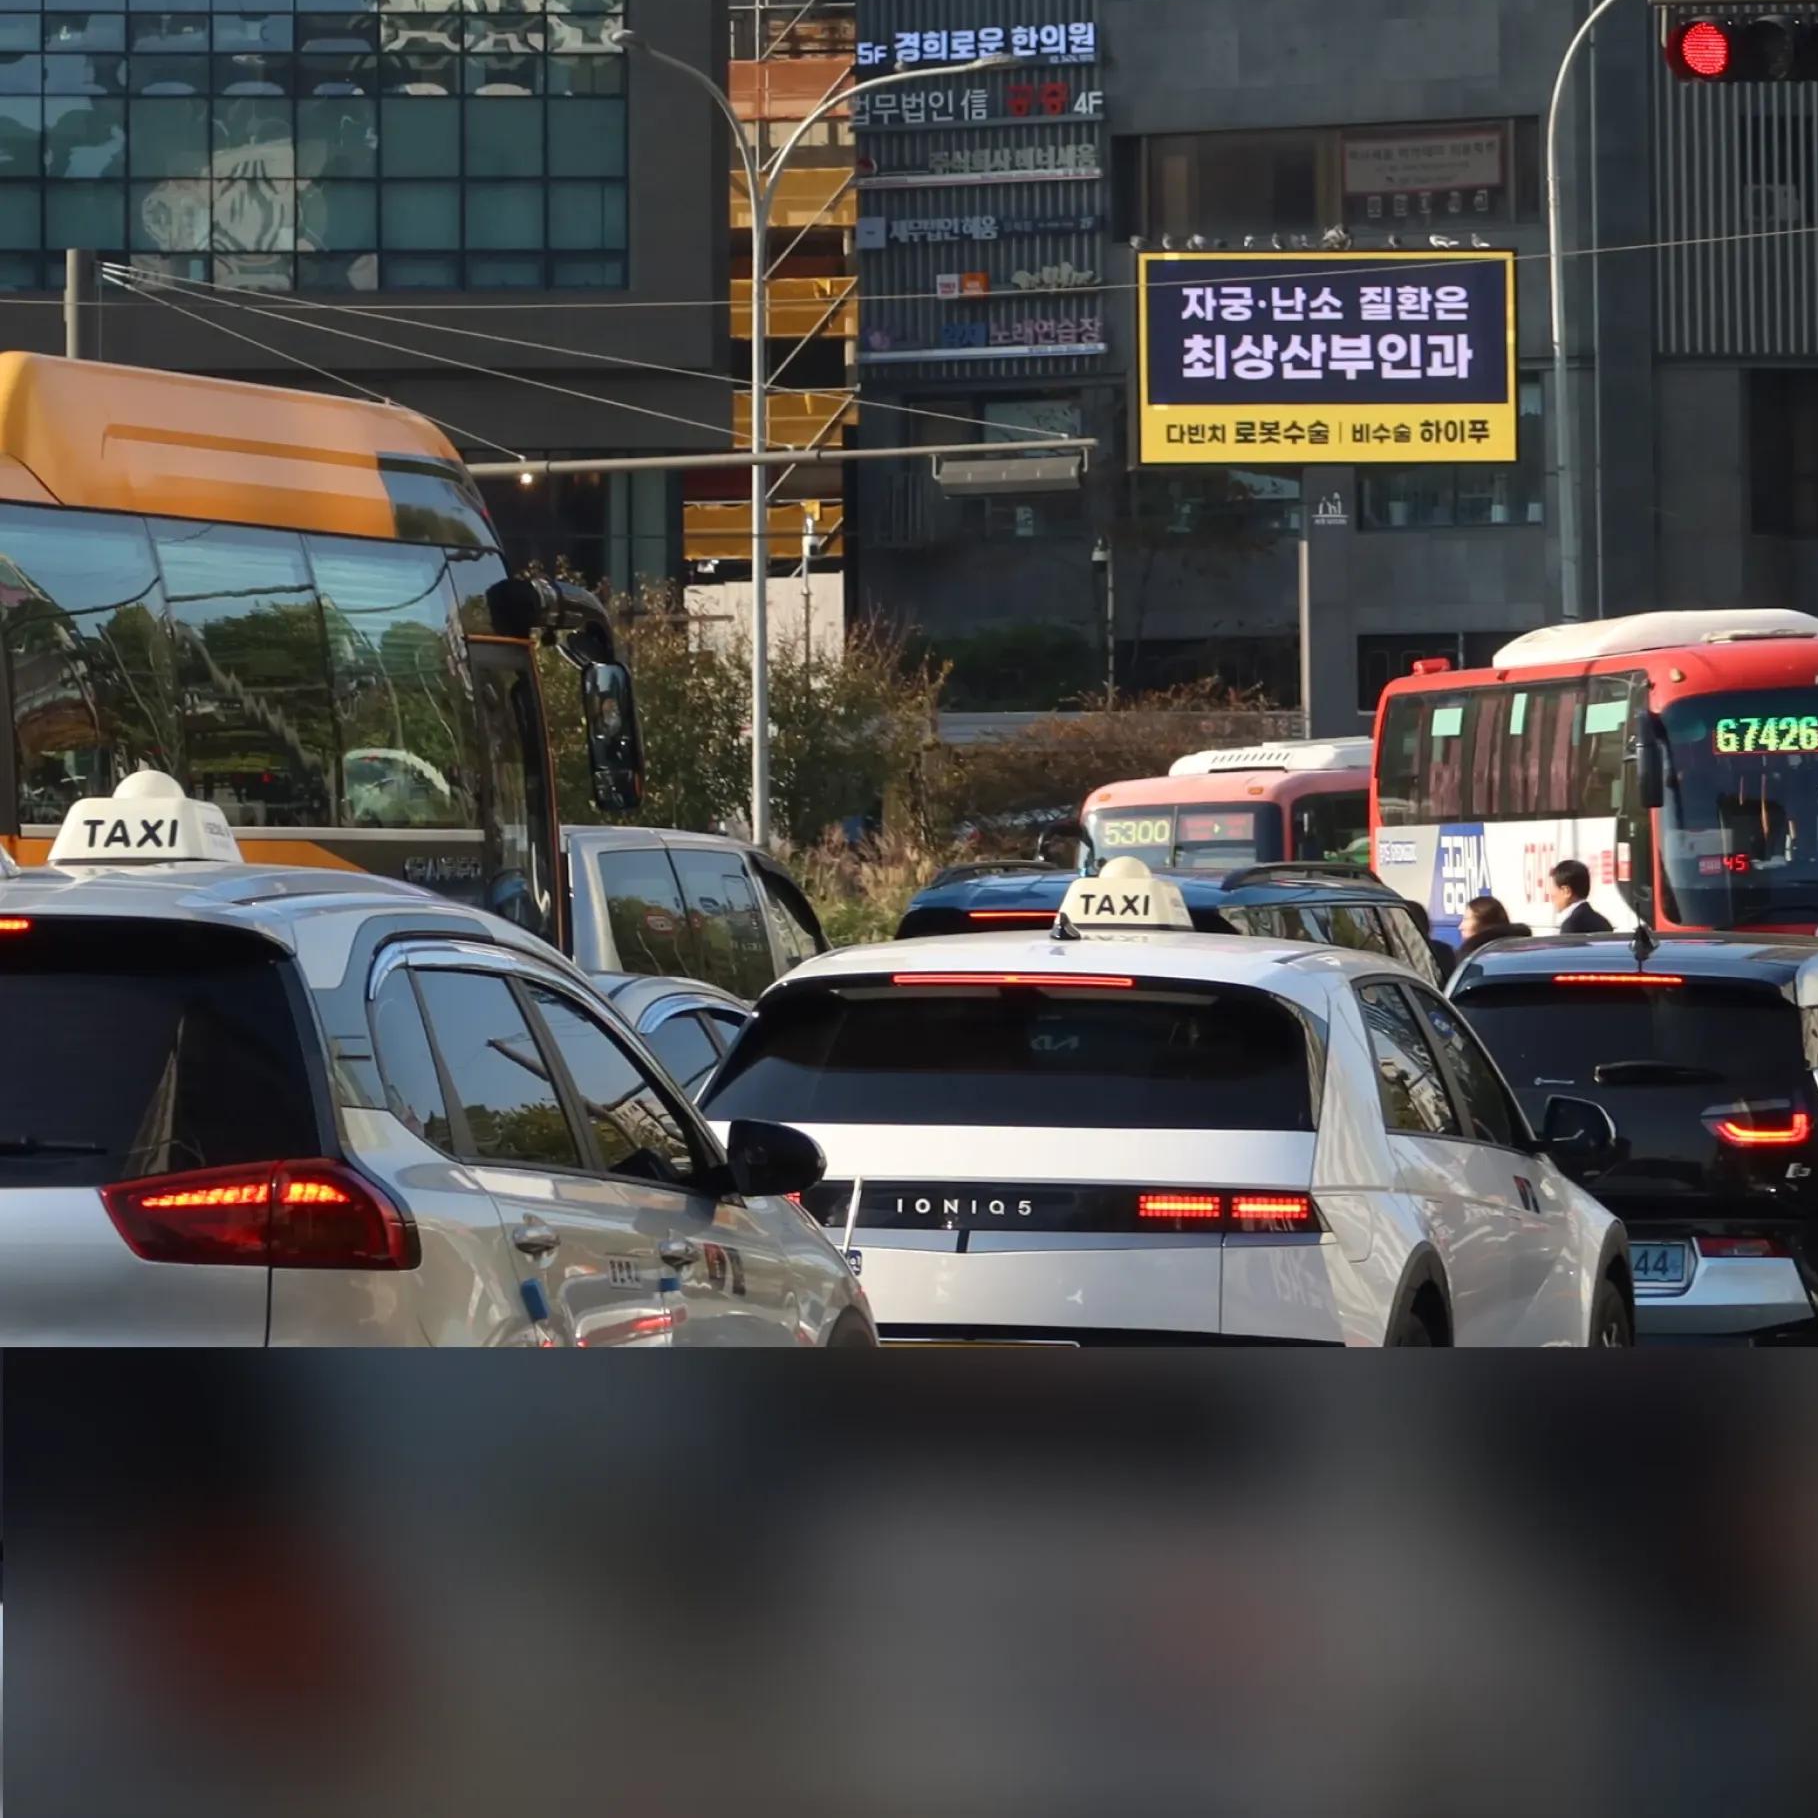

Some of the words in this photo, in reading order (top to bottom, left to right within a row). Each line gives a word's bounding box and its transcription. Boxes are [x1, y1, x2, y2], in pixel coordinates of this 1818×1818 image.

[857, 42, 888, 66] 5F
[893, 26, 1005, 63] 경희로운
[1010, 21, 1096, 56] 한의원
[1073, 90, 1104, 115] 4F
[1180, 285, 1345, 322] 자궁·난소
[1358, 284, 1470, 322] 질환은
[1181, 333, 1475, 381] 최상산부인과
[1166, 423, 1227, 445] 다빈치
[1234, 420, 1330, 445] 로봇수술
[1351, 422, 1412, 444] 비수술
[1419, 419, 1491, 445] 하이푸
[83, 819, 178, 848] TAXI
[1104, 819, 1171, 846] 5300
[1722, 853, 1748, 871] 45
[1079, 893, 1151, 917] TAXI
[897, 1197, 1006, 1216] IONIQ
[1018, 1198, 1033, 1216] 5
